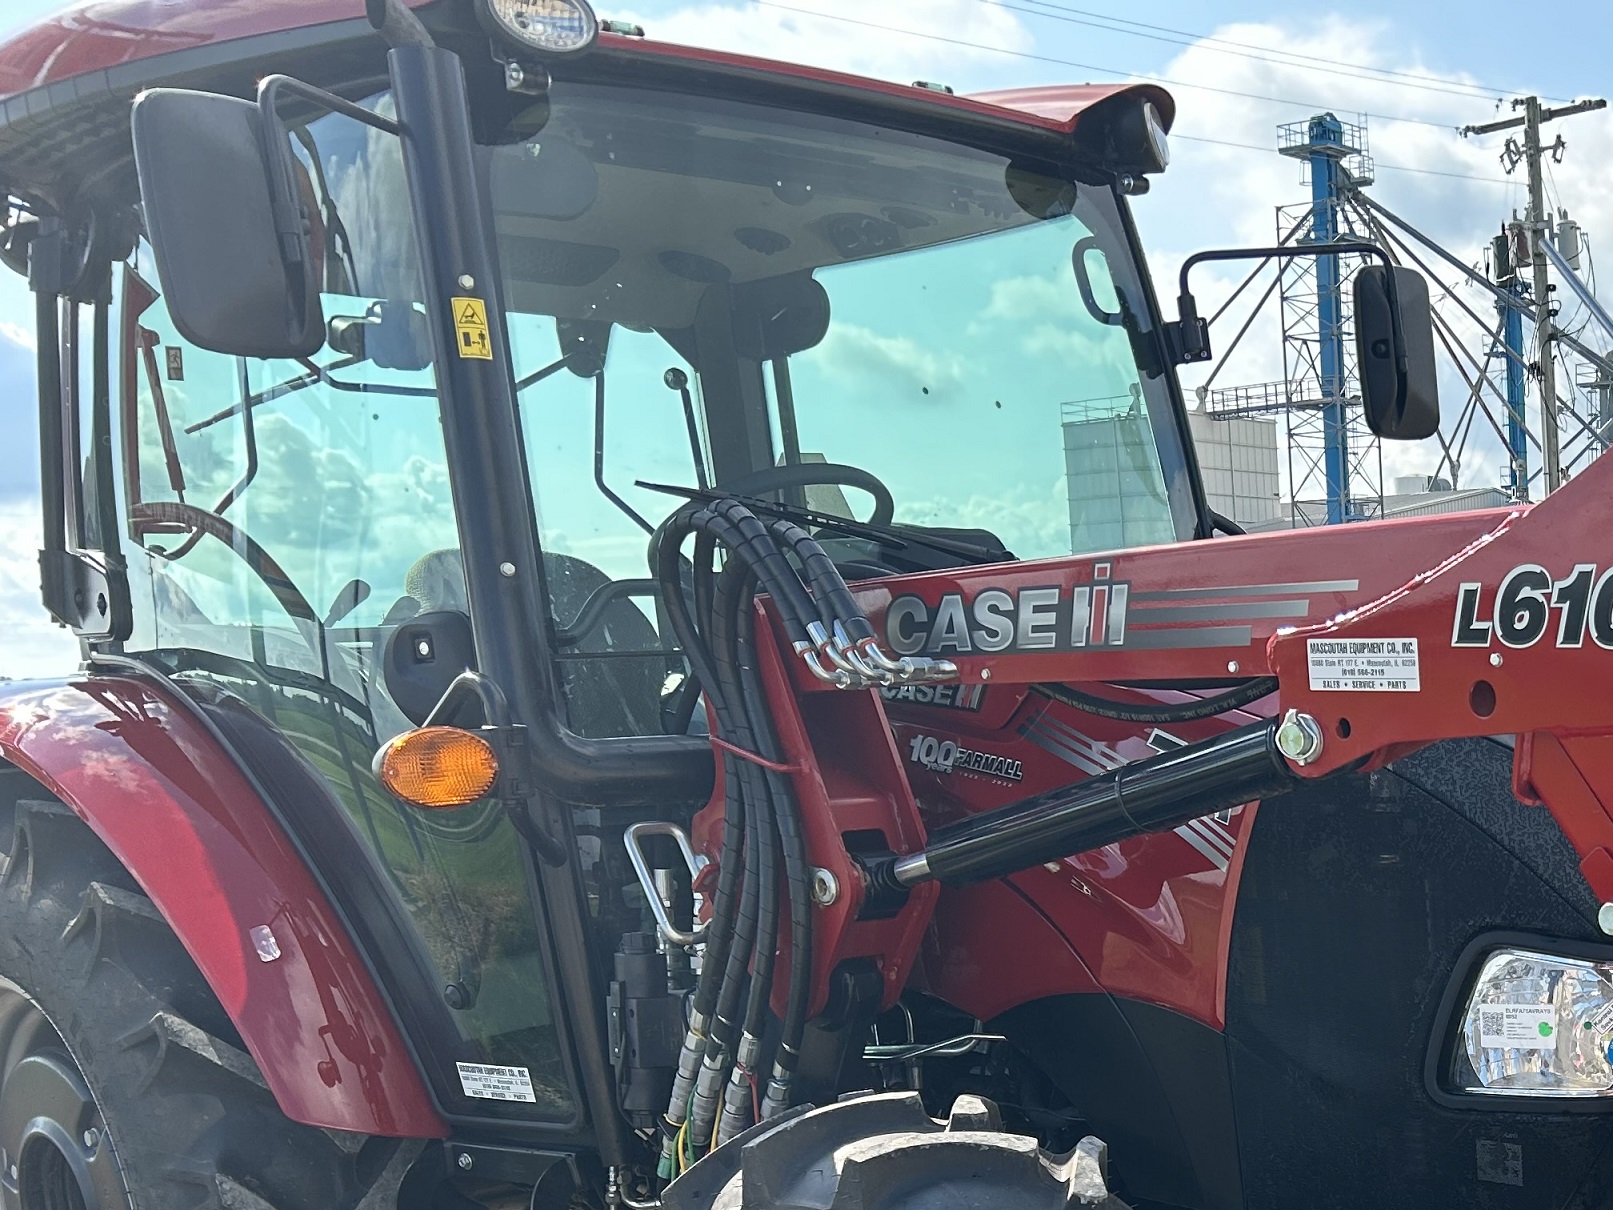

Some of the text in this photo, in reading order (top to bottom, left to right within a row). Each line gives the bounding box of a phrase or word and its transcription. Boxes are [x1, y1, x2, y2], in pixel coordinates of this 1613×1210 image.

[887, 588, 1060, 655] CASE
[1310, 642, 1347, 654] MASCOUTAH
[1349, 642, 1385, 655] EQUIPMENT
[1402, 642, 1415, 654] INC.
[1322, 681, 1407, 689] SALES SERVICE PARTS
[910, 734, 1023, 780] 100 FARMALL
[926, 760, 953, 774] years
